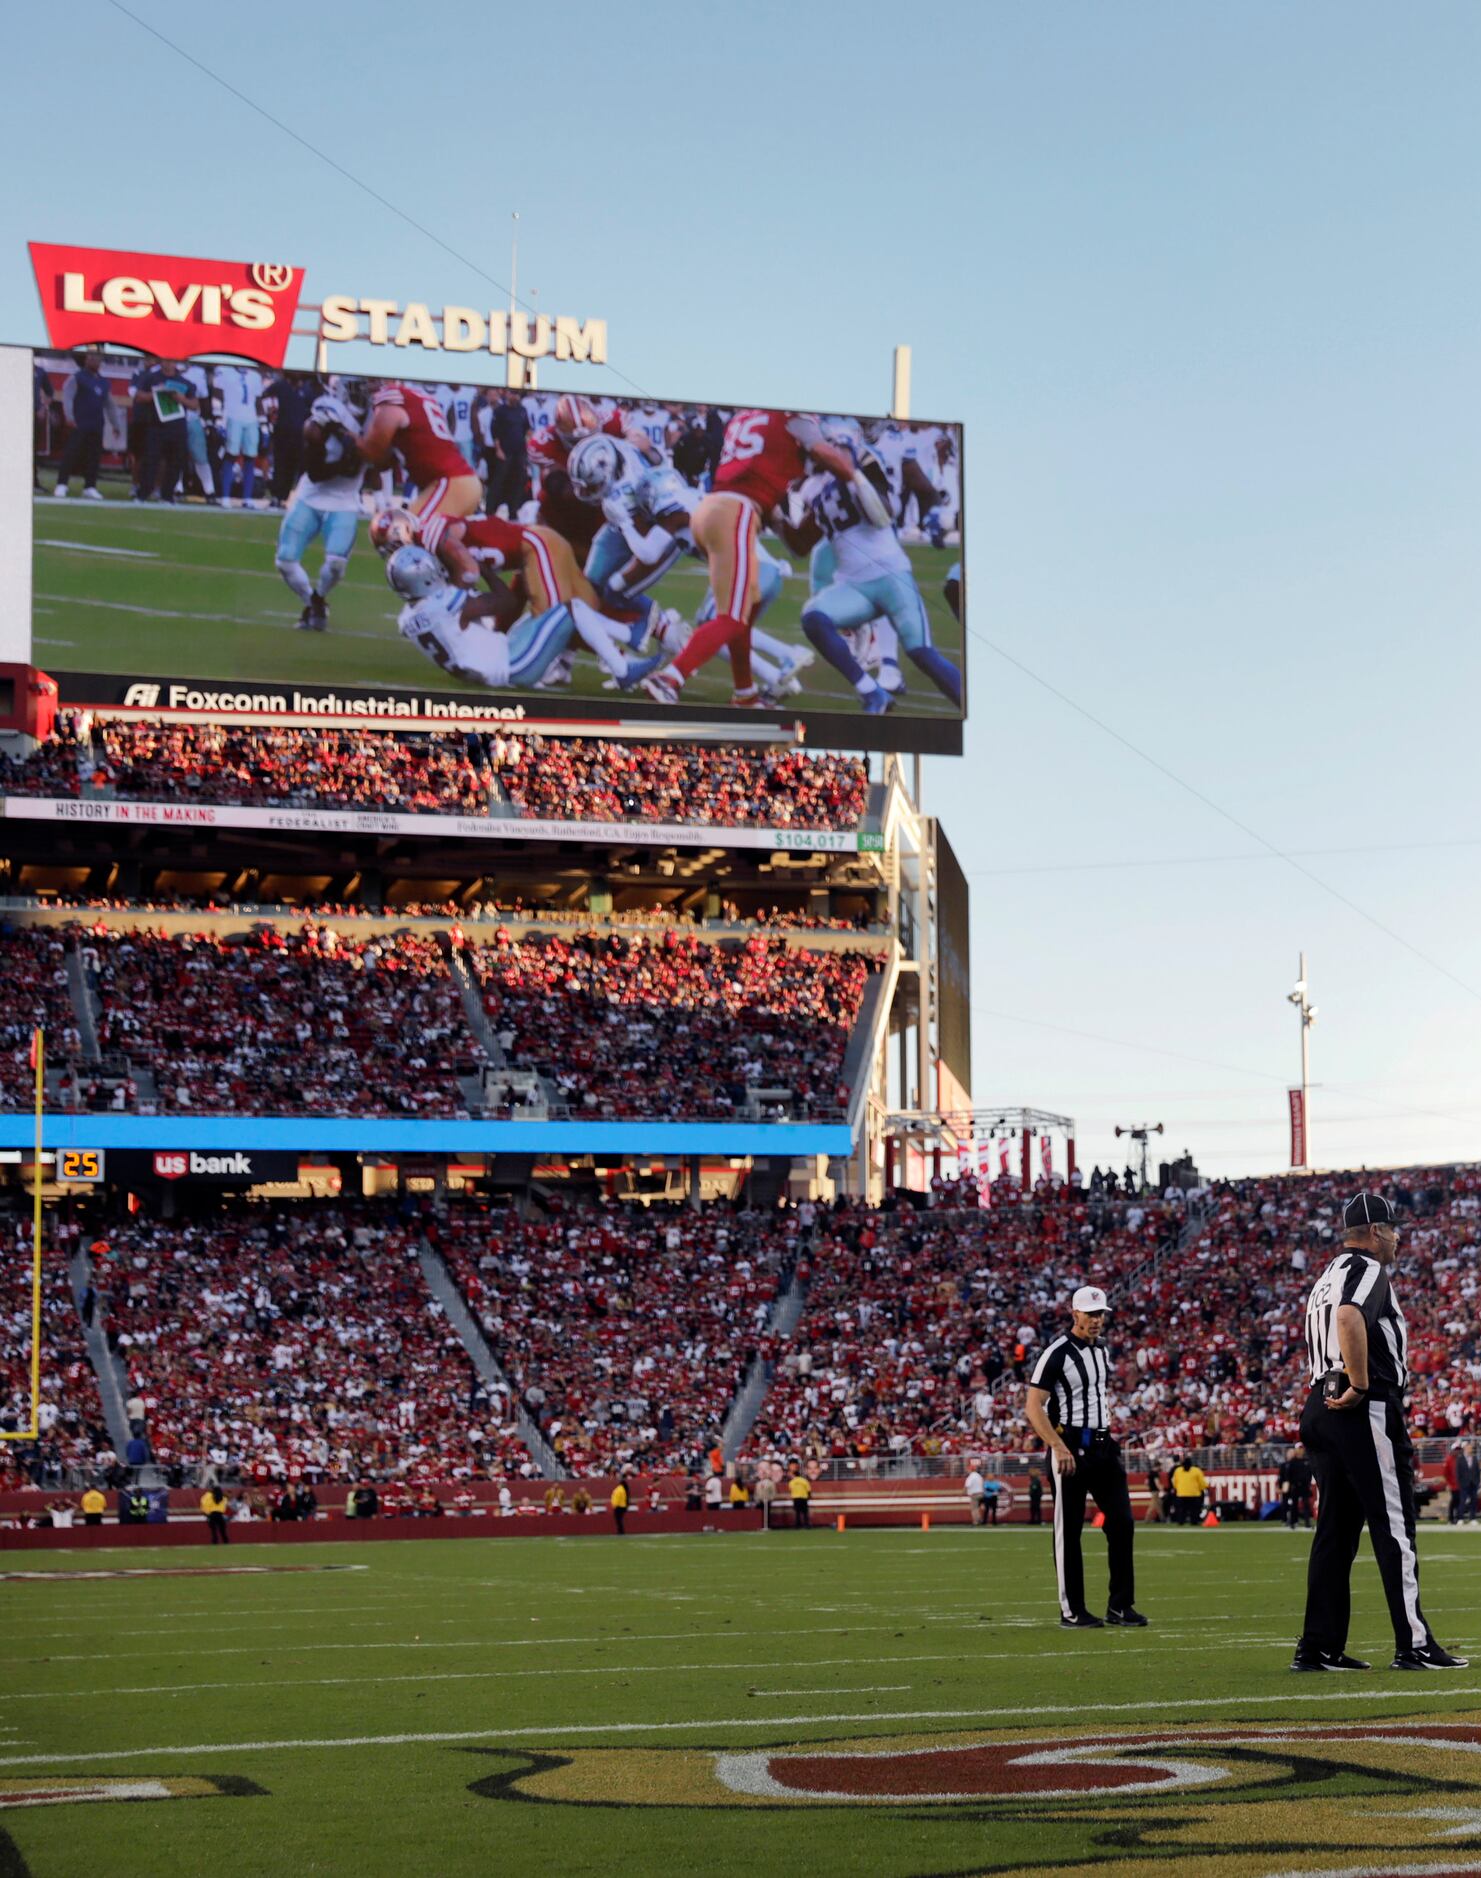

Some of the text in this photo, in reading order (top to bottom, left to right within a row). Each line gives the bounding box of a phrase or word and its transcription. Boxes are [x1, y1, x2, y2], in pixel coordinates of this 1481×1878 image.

[320, 294, 609, 364] STADIUM
[168, 684, 288, 713] Foxconn
[293, 691, 419, 717] Industrial
[424, 698, 526, 721] Internet
[55, 802, 216, 823] HISTORY IN THE MAKING
[774, 832, 846, 849] $104,017
[63, 1151, 99, 1177] 25
[155, 1151, 252, 1175] us bank
